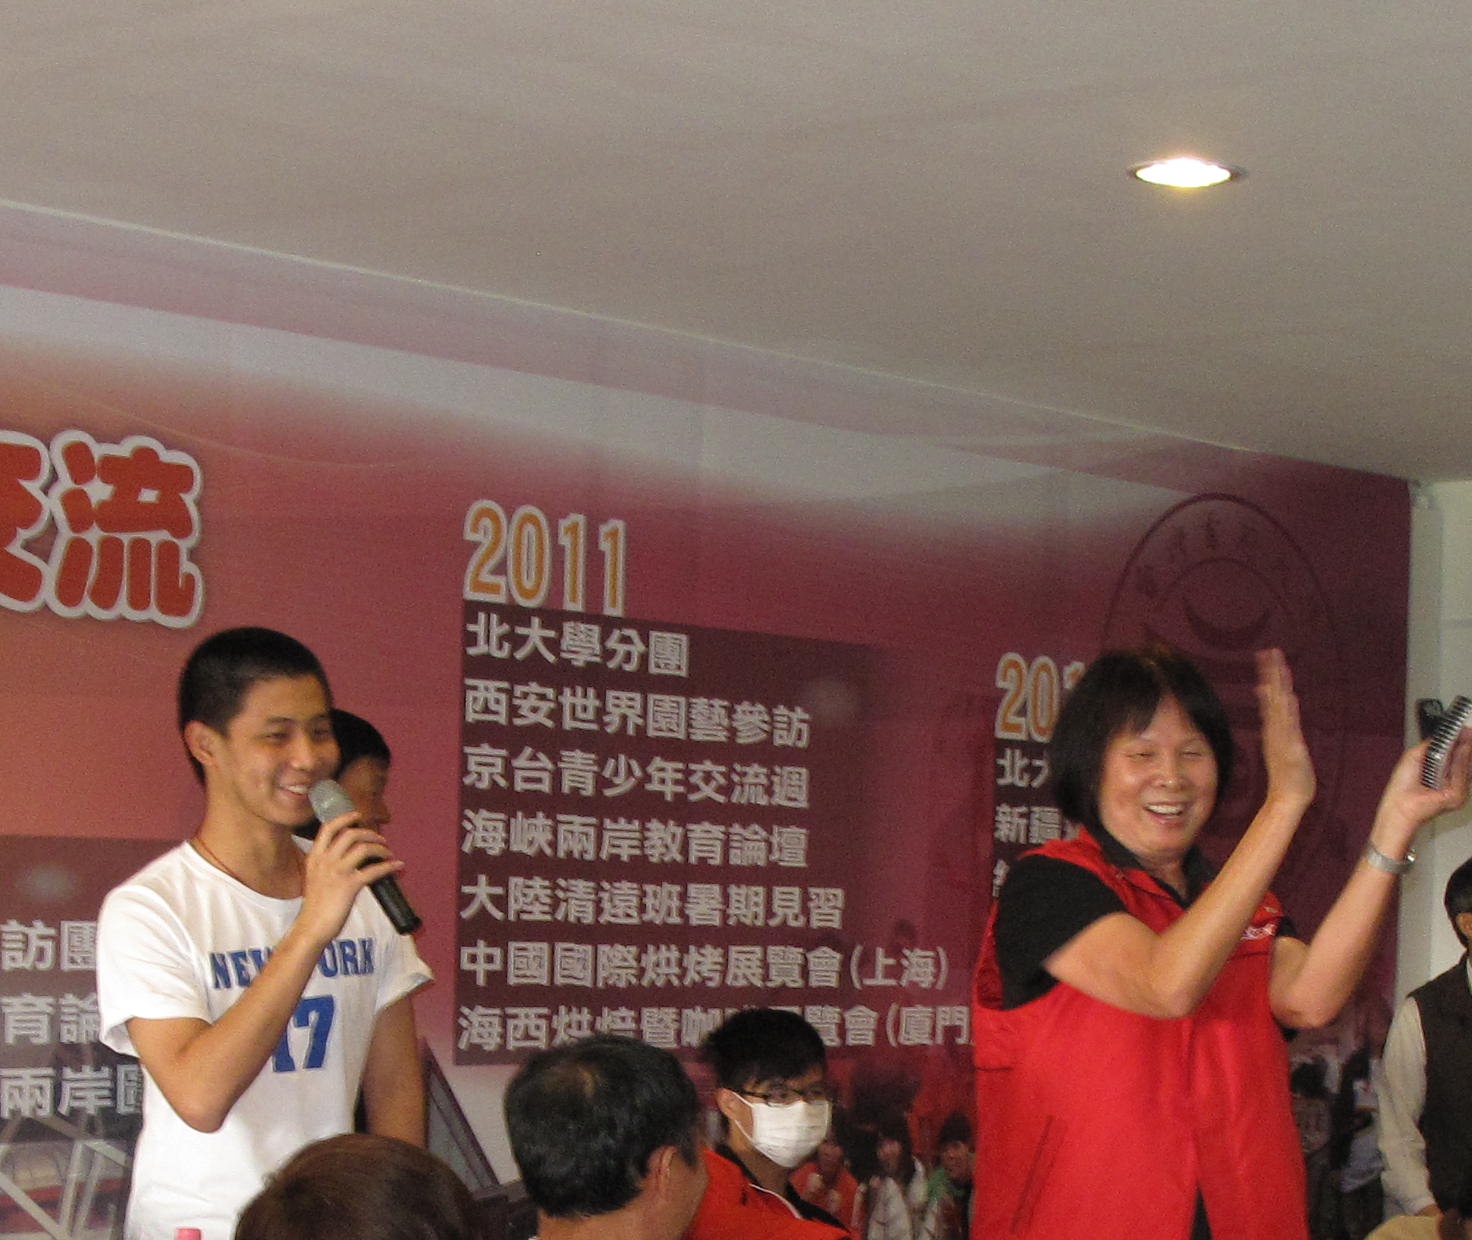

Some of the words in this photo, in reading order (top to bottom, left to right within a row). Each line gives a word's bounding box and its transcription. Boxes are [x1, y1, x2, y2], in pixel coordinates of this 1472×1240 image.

[463, 499, 627, 617] 2011
[466, 611, 690, 678] 北大學分團
[463, 677, 812, 749] 西安世界園藝參訪
[994, 652, 1086, 743] 20
[461, 743, 811, 810] 京台青少年交流週
[460, 808, 810, 868] 海峽兩岸教育論壇
[317, 937, 375, 978] ORK
